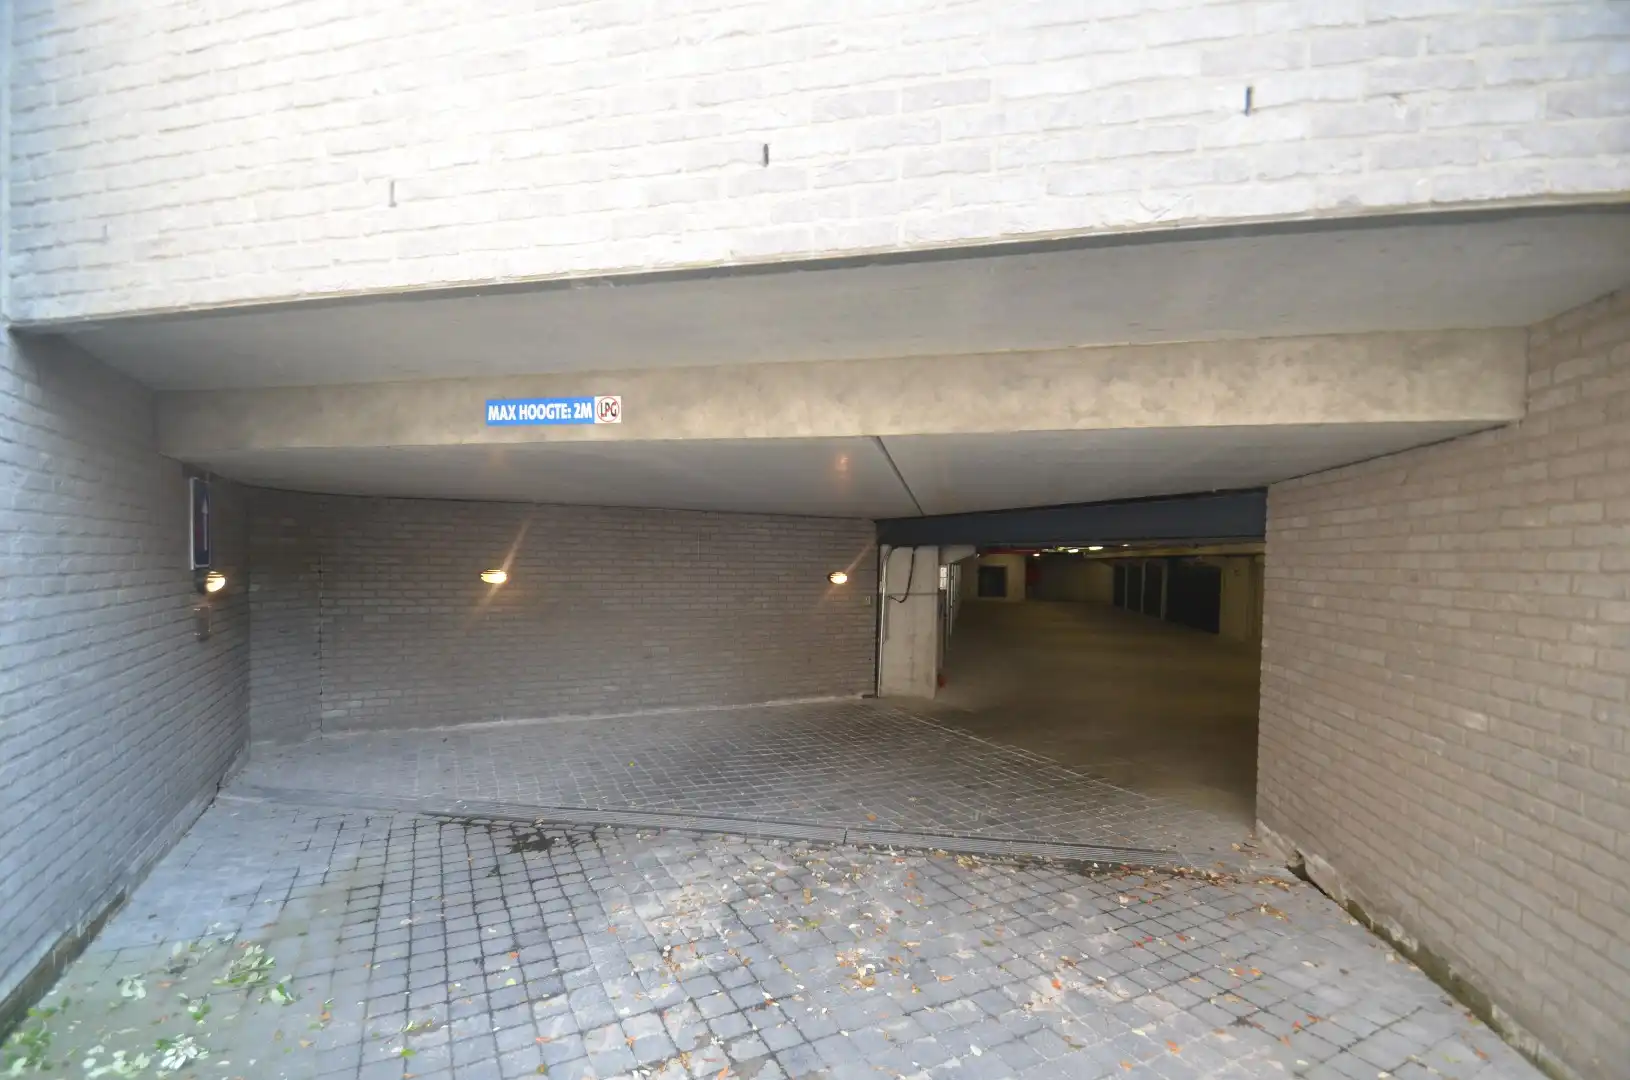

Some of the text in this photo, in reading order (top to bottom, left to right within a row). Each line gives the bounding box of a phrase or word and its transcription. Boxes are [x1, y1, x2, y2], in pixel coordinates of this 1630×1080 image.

[488, 402, 592, 420] MAX HOOGTE: 2M
[600, 401, 617, 417] LPG
